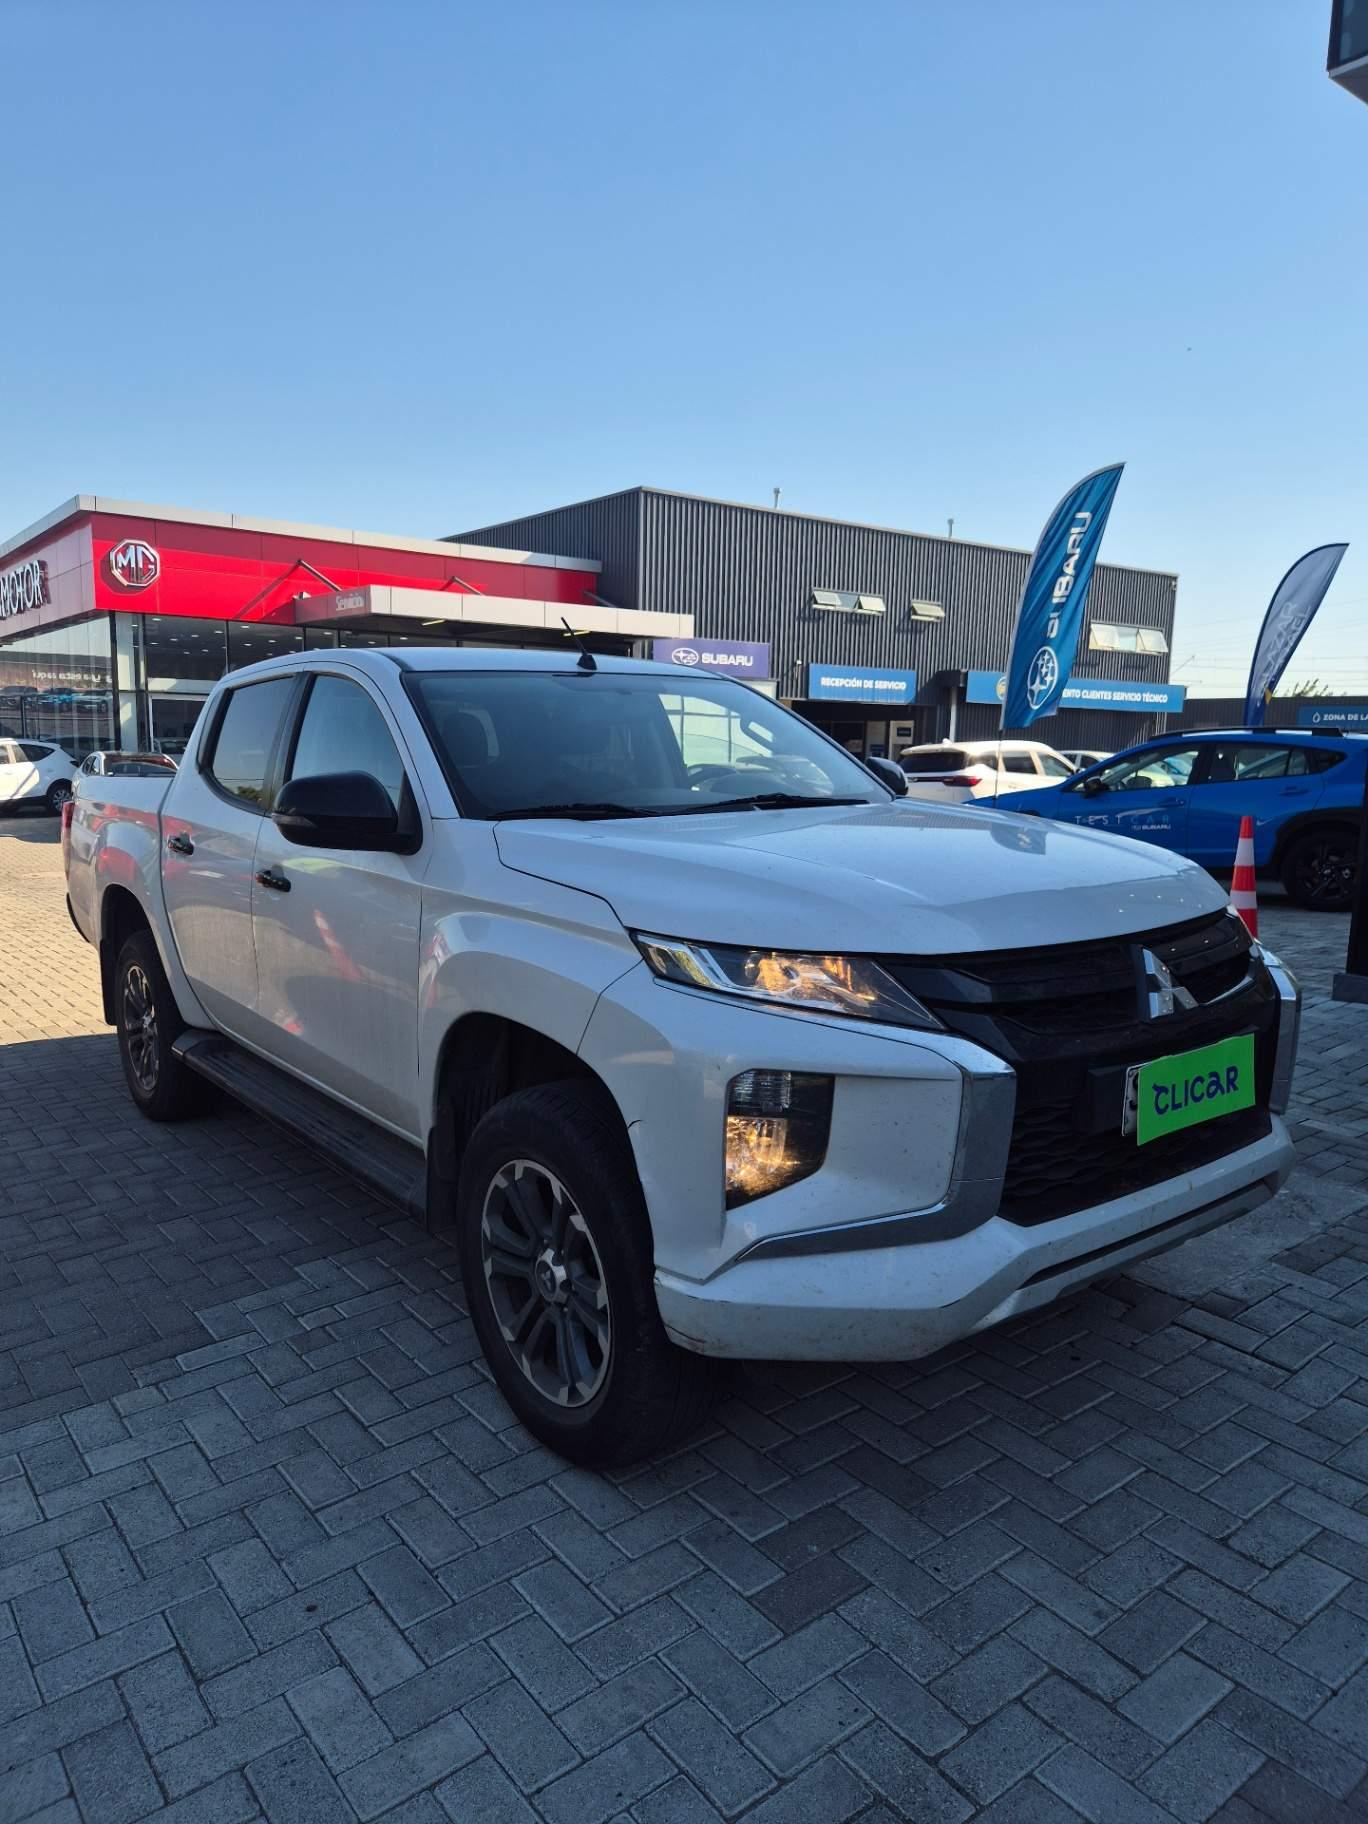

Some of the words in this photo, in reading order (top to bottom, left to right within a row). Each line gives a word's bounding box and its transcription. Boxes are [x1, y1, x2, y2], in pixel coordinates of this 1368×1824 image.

[115, 543, 157, 584] MG
[0, 560, 43, 618] MOTOR
[701, 652, 754, 666] SUBARU
[820, 677, 862, 689] RECEPCIÓN
[863, 680, 874, 689] DE
[874, 681, 907, 691] SERVICIO
[1061, 688, 1081, 698] ENTO
[1081, 689, 1112, 700] CLIENTES
[1112, 690, 1142, 702] SERVICIO
[1142, 690, 1169, 703] TÉCNICO
[1322, 713, 1346, 721] ZONA
[1347, 713, 1359, 721] DE
